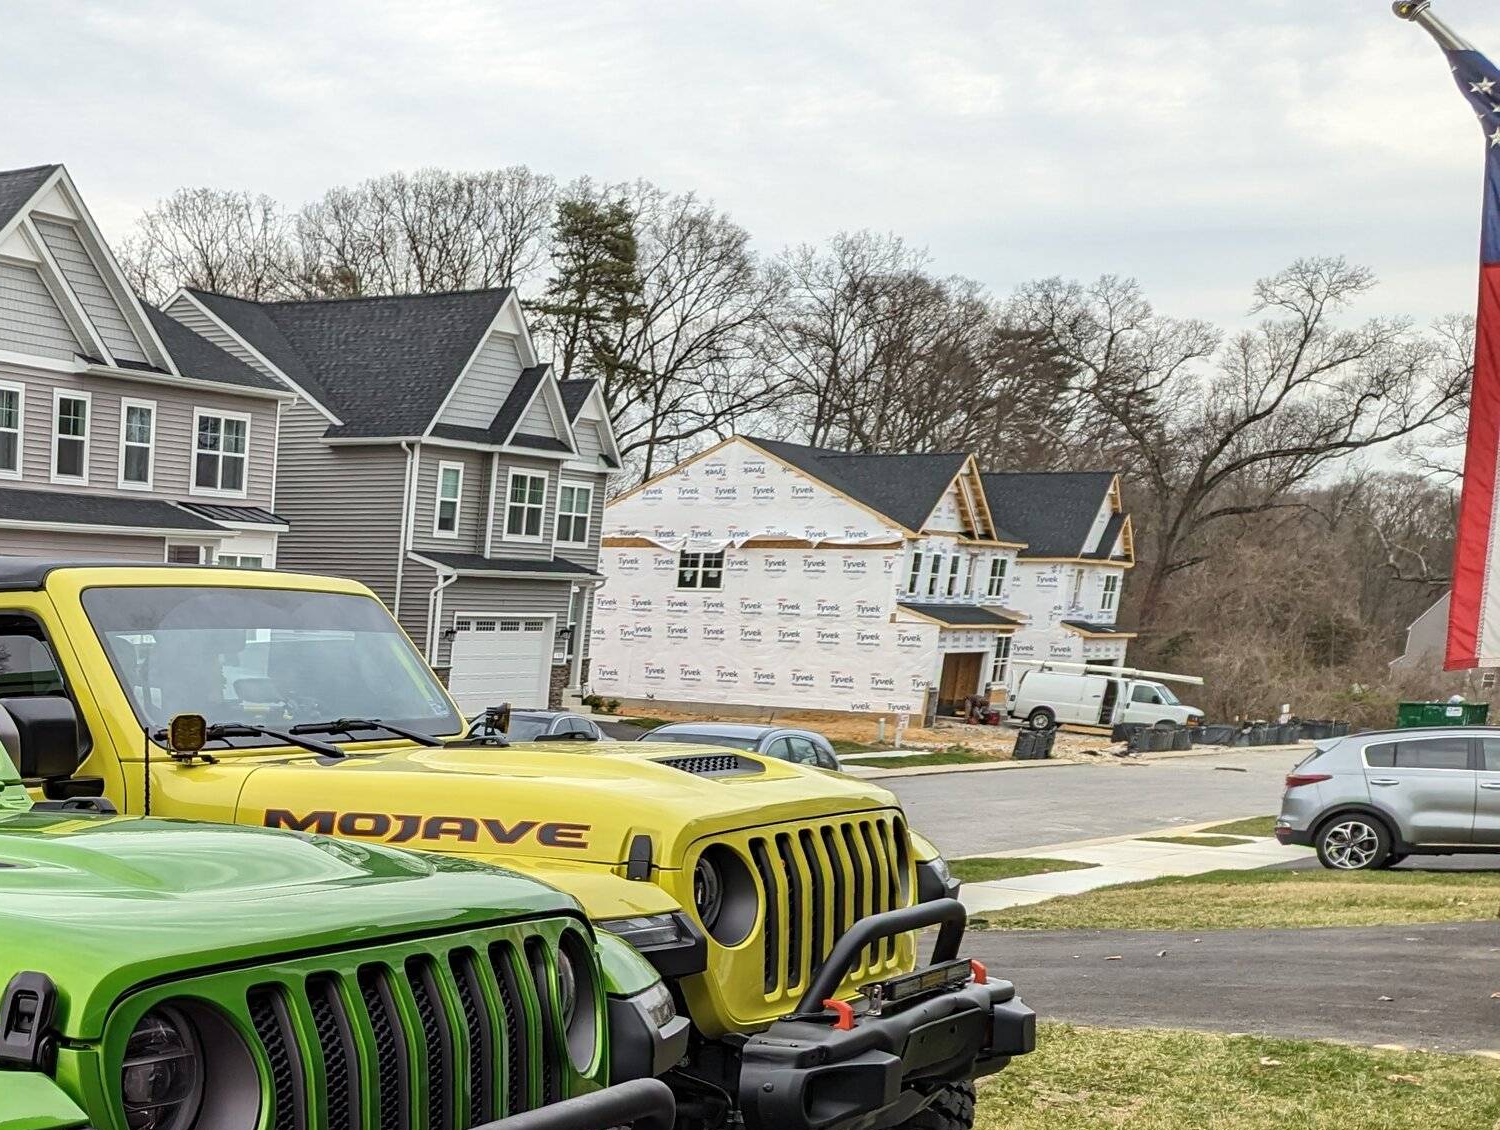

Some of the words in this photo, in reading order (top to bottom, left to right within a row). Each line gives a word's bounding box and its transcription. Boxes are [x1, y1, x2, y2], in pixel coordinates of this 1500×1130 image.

[678, 487, 700, 495] Tyvek
[715, 486, 736, 495] Tyvek
[752, 487, 776, 495] Tyvek
[791, 486, 814, 495] Tyvek
[654, 530, 677, 538] Tyvek
[690, 529, 714, 538] Tyvek
[727, 530, 750, 538] Tyvek
[804, 530, 828, 539] Tyvek
[844, 530, 868, 538] Tyvek
[618, 557, 640, 566] Tyvek
[654, 558, 675, 566] Tyvek
[726, 558, 748, 567] Tyvek
[765, 559, 788, 568] Tyvek
[803, 559, 826, 568] Tyvek
[843, 560, 867, 569] Tyvek
[597, 598, 617, 606] Tyvek
[631, 599, 652, 607] Tyvek
[703, 600, 724, 609] Tyvek
[740, 600, 762, 610] Tyvek
[776, 603, 800, 611] Tyvek
[817, 603, 841, 613] Tyvek
[856, 605, 880, 614] Tyvek
[667, 626, 688, 634] Tyvek
[703, 627, 724, 636] Tyvek
[740, 628, 762, 637] Tyvek
[778, 630, 801, 639] Tyvek
[817, 631, 840, 640] Tyvek
[856, 632, 880, 641] Tyvek
[897, 634, 921, 643] Tyvek
[1011, 644, 1034, 652] Tyvek
[599, 668, 618, 677] Tyvek
[644, 666, 665, 675] Tyvek
[680, 668, 701, 677] Tyvek
[716, 670, 738, 678] Tyvek
[754, 672, 776, 680] Tyvek
[791, 673, 814, 682] Tyvek
[831, 675, 854, 684] Tyvek
[871, 677, 894, 686] Tyvek
[887, 703, 911, 712] Tyvek
[263, 808, 592, 849] MOJAVE
